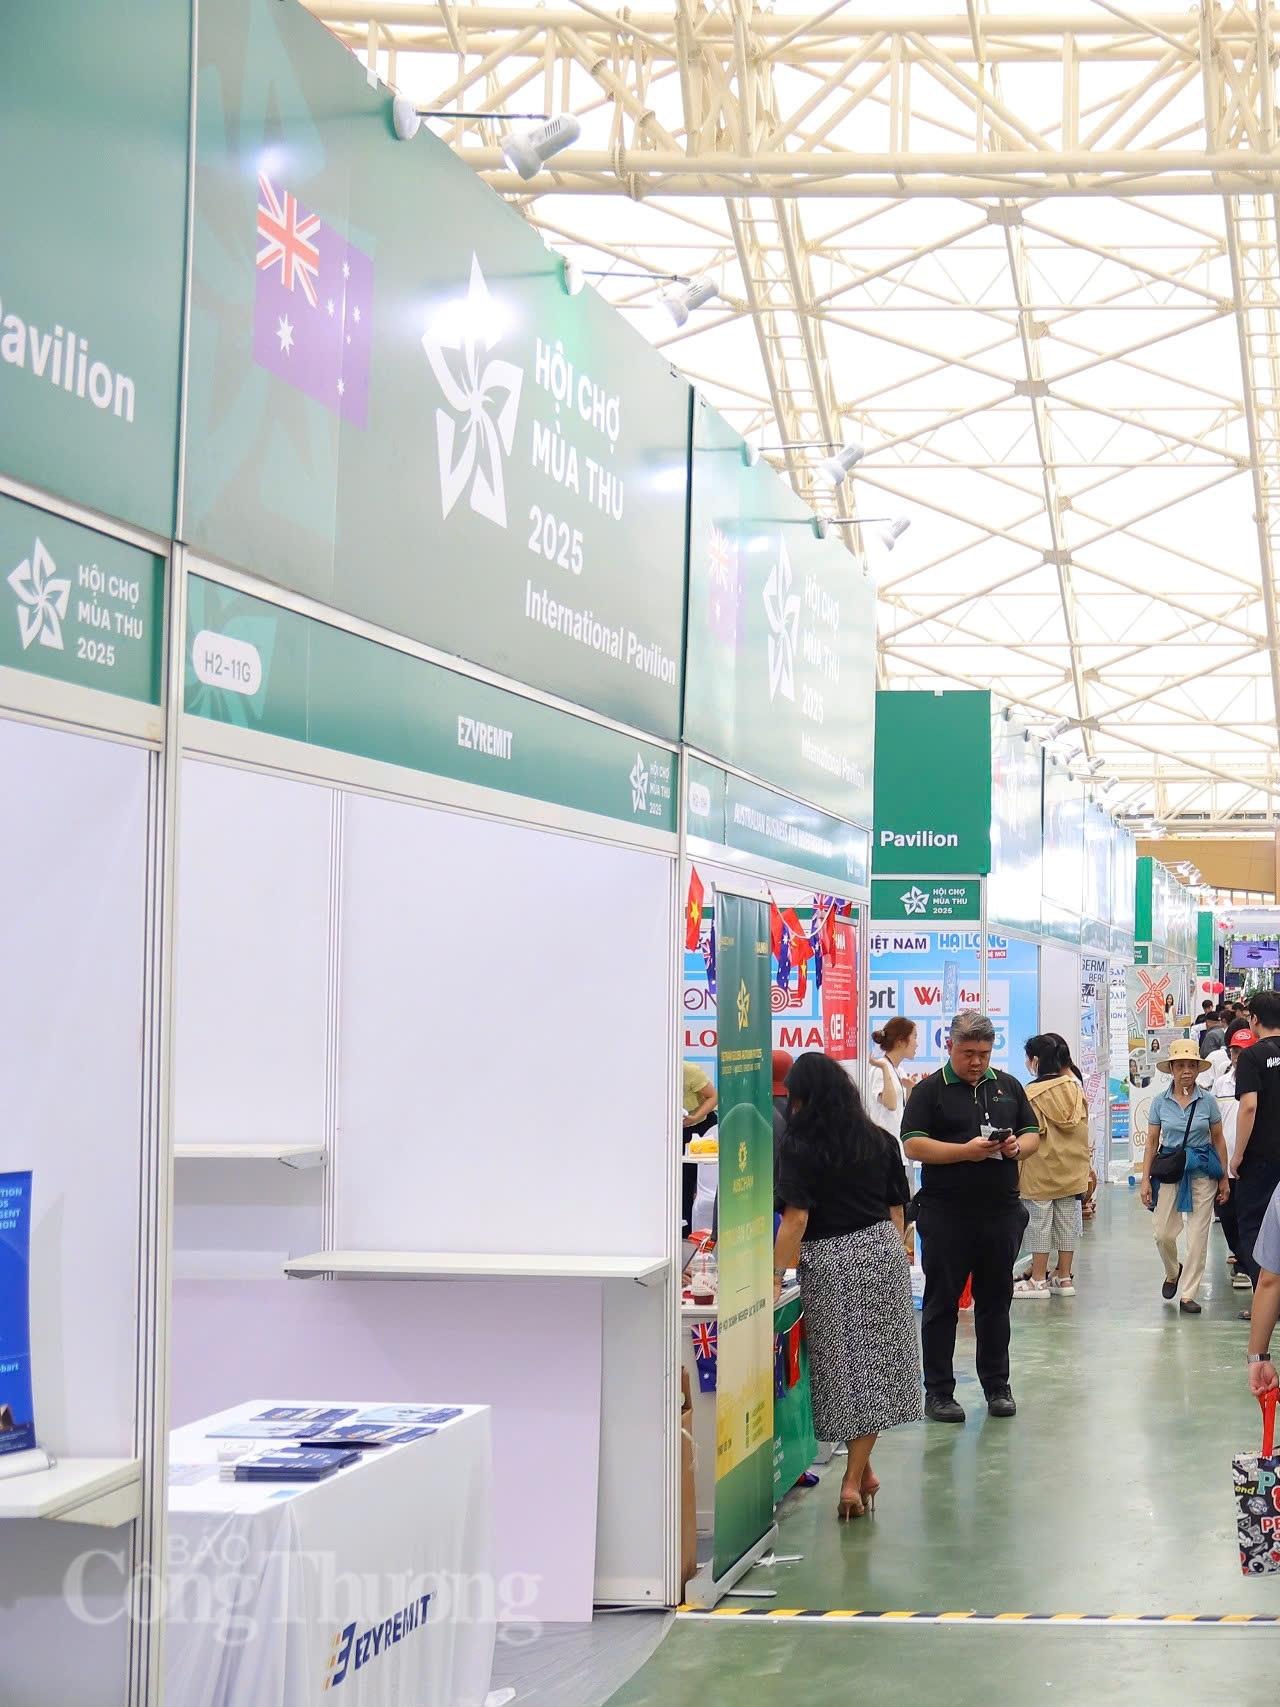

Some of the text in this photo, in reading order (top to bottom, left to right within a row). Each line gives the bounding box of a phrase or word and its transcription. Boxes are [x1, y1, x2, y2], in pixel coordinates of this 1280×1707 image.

[0, 297, 135, 424] avilion
[535, 336, 621, 454] HỘI CHỢ
[532, 419, 624, 521] MÙA THU
[528, 505, 584, 576] 2025
[80, 563, 140, 609] HỘI CHỢ
[78, 599, 143, 640] MÙA THU
[525, 578, 676, 686] International Pavilion
[77, 637, 116, 667] 2025
[204, 650, 252, 684] H2-11G
[457, 715, 513, 760] EZYREMIT
[880, 830, 958, 848] Pavilion
[933, 888, 966, 897] HỘI CHỢ
[933, 896, 968, 905] MÙA THU
[933, 907, 953, 915] 2025
[893, 938, 927, 950] NAM
[1235, 1485, 1255, 1496] and
[354, 1593, 432, 1672] EZYREMIT
